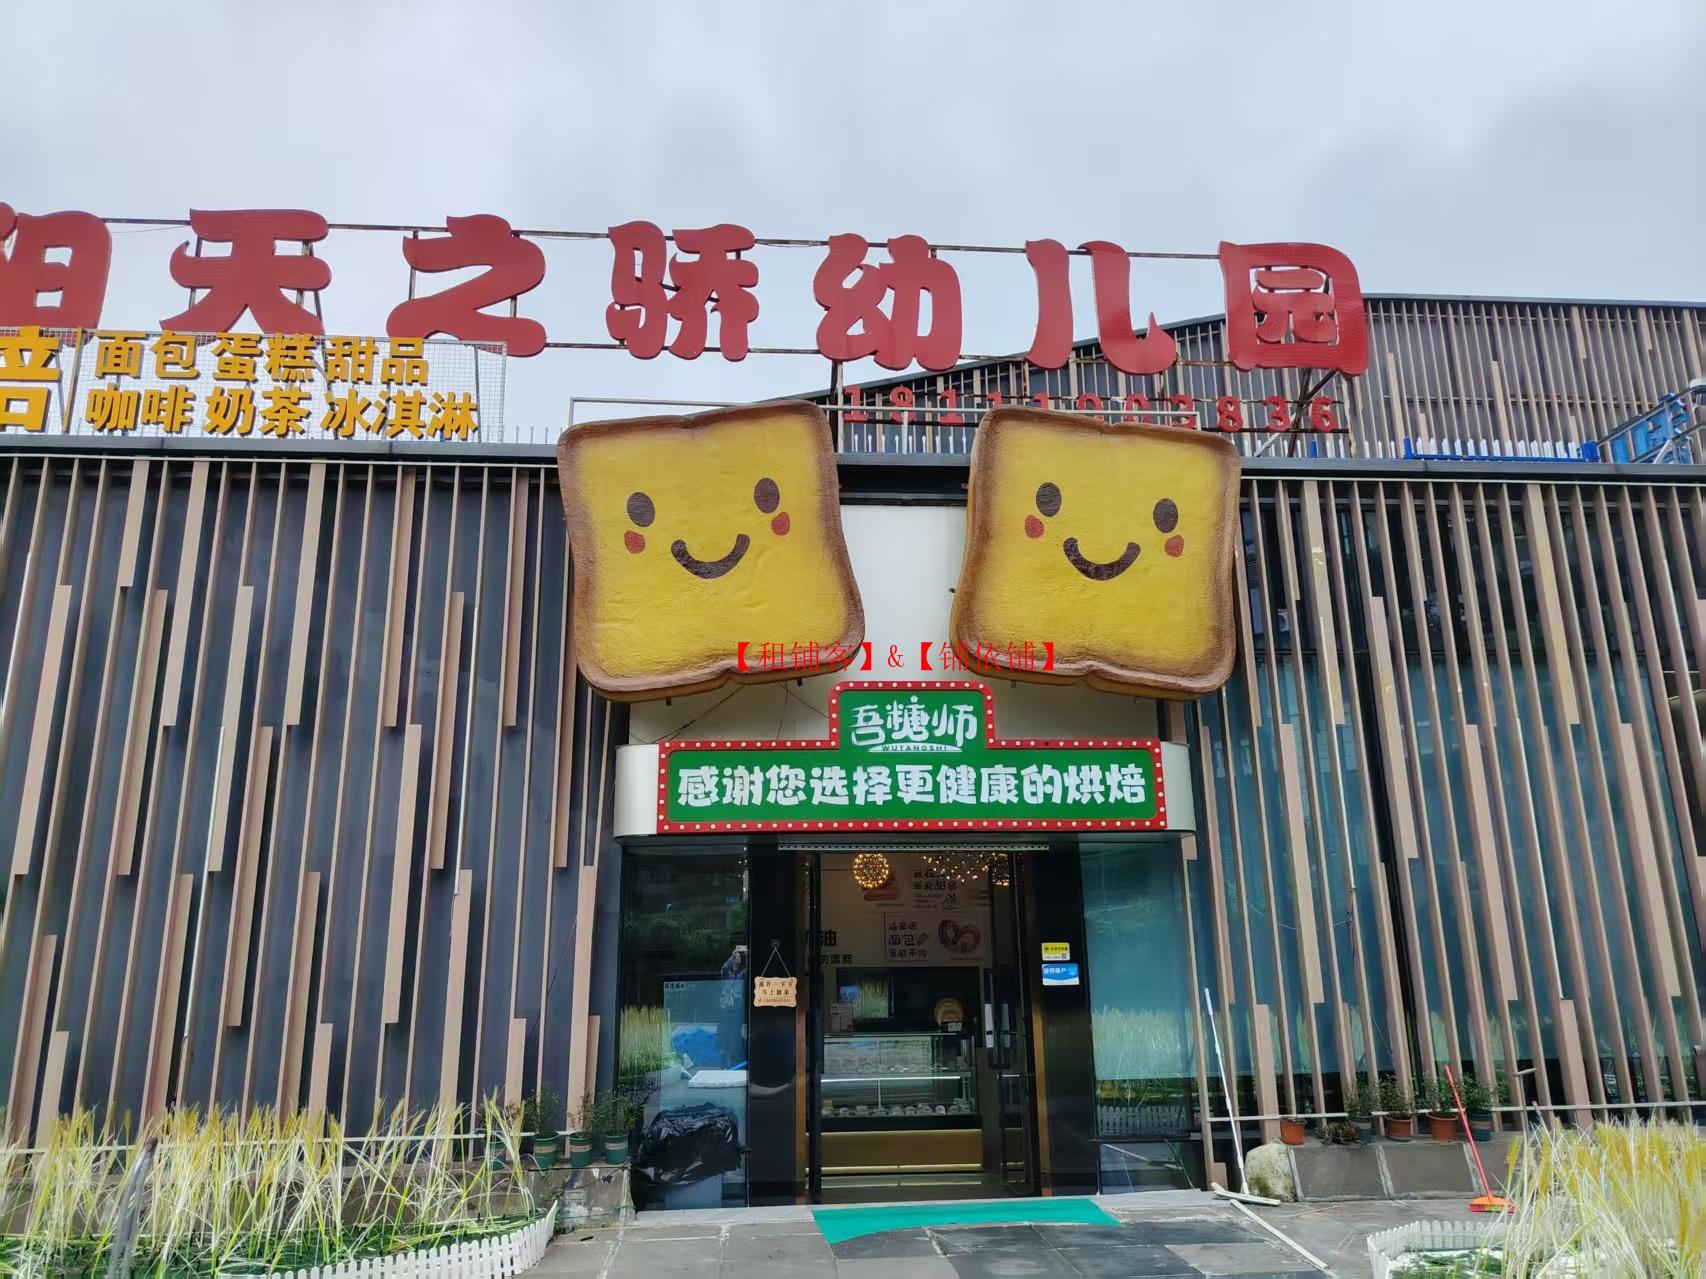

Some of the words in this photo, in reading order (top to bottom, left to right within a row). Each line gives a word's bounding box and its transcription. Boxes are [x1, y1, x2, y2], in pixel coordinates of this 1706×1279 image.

[677, 763, 1146, 806] 感谢您选择更健康的烘焙
